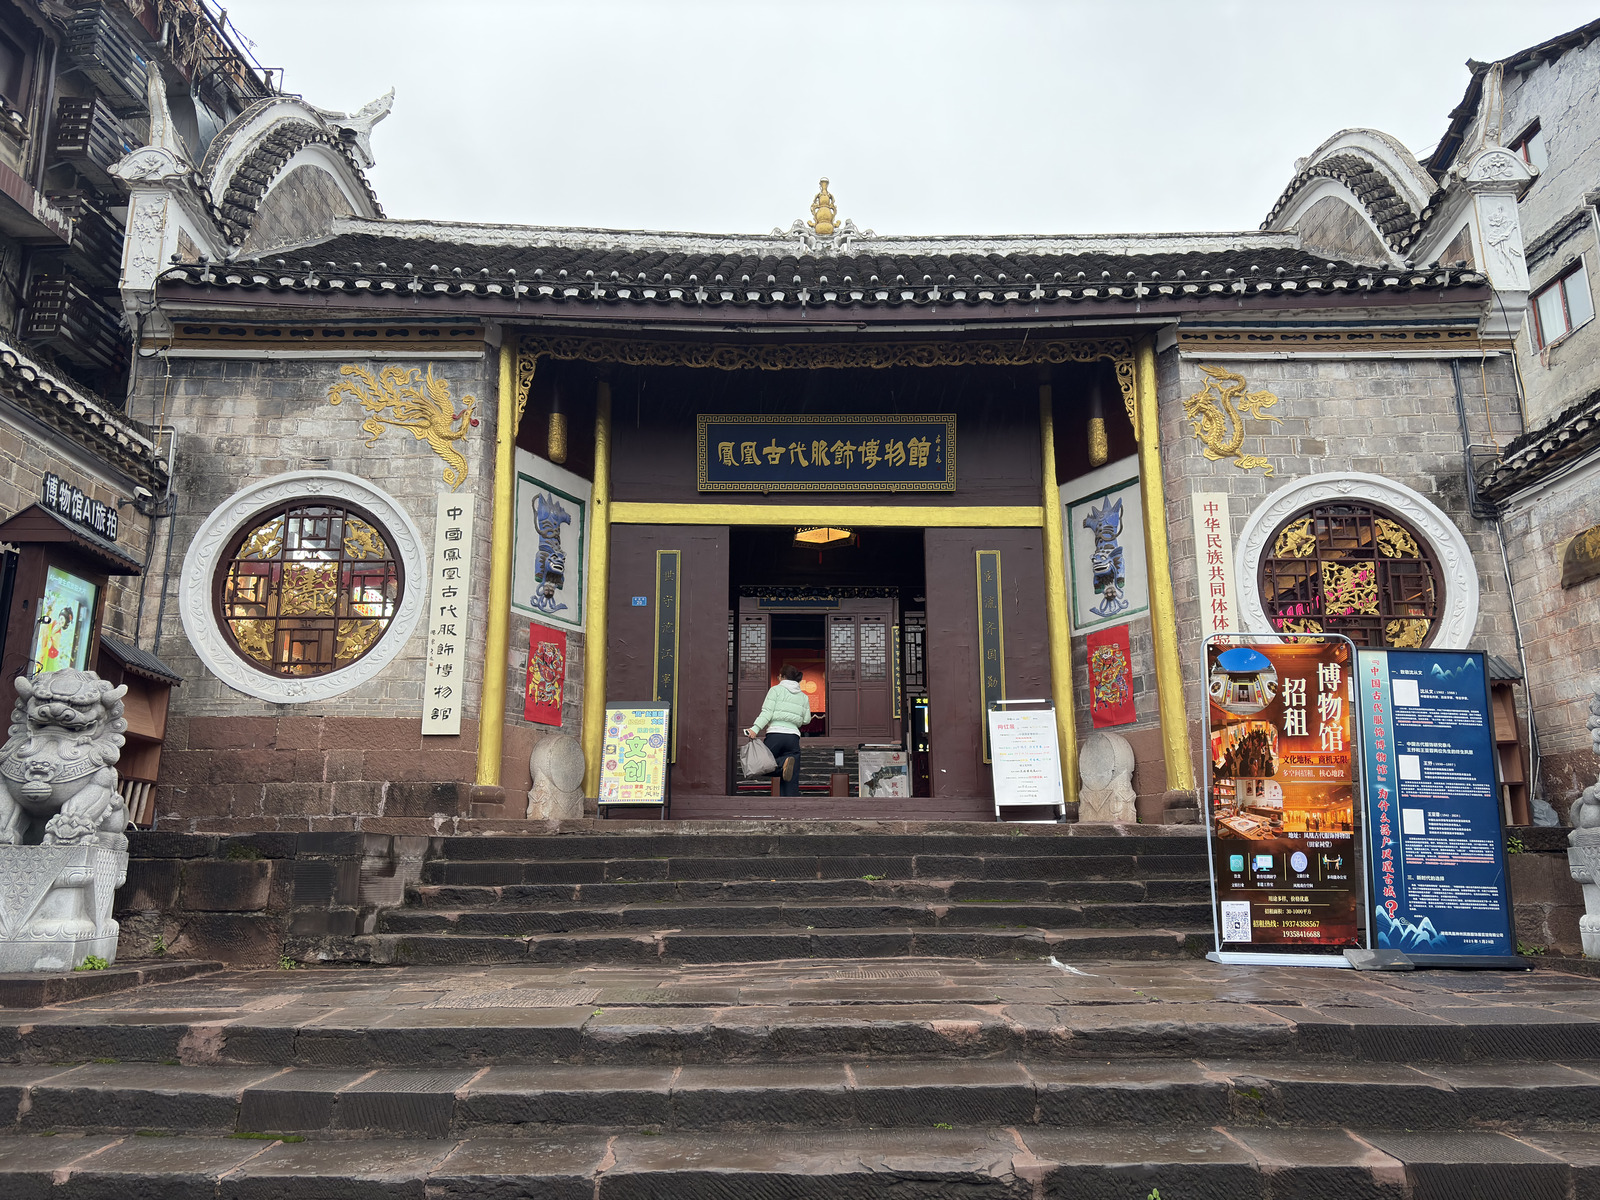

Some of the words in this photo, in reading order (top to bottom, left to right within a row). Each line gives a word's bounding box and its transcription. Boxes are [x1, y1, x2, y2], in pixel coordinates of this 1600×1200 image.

[46, 474, 118, 538] 博物馆AI旅拍
[430, 506, 463, 721] 中國鳳凰古代服飾博物館
[1282, 677, 1309, 737] 招租
[1317, 662, 1343, 751] 博物馆
